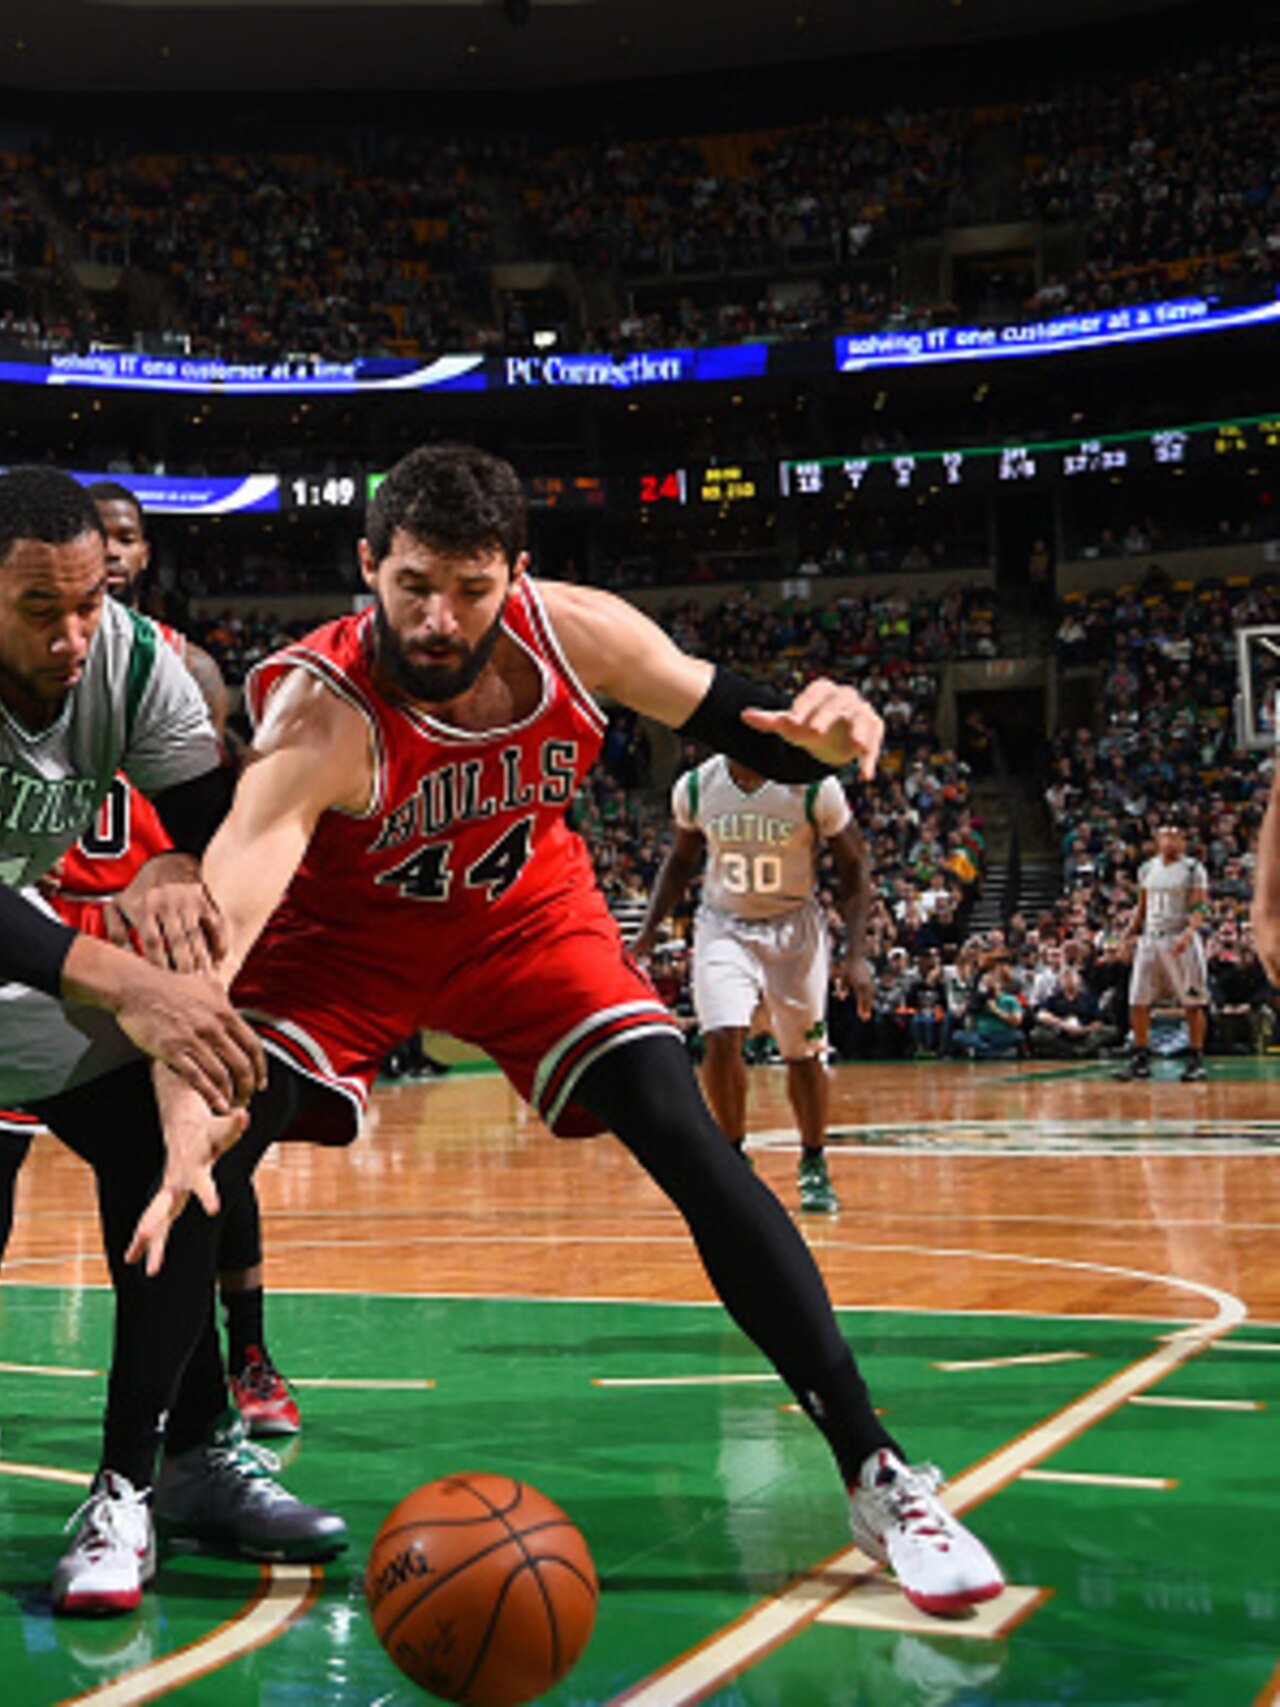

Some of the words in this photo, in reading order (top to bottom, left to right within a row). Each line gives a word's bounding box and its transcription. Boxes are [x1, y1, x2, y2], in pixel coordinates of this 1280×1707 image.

[848, 332, 924, 356] solving
[927, 329, 949, 350] IT
[956, 329, 997, 347] one
[1001, 315, 1101, 343] customer
[1107, 310, 1131, 330] at
[1137, 308, 1151, 324] a
[1156, 298, 1208, 321] time
[51, 353, 116, 377] solving
[120, 354, 138, 373] IT
[142, 358, 177, 375] one
[181, 359, 267, 379] customer
[271, 360, 290, 379] at
[297, 365, 307, 378] a
[314, 358, 355, 379] time
[507, 357, 540, 385] PC
[542, 354, 681, 385] Connection
[292, 477, 355, 506] 1:49
[639, 474, 679, 502] 24
[366, 737, 578, 855] BULLS
[706, 812, 793, 847] CELTICS
[373, 812, 536, 902] 44
[721, 852, 783, 894] 30
